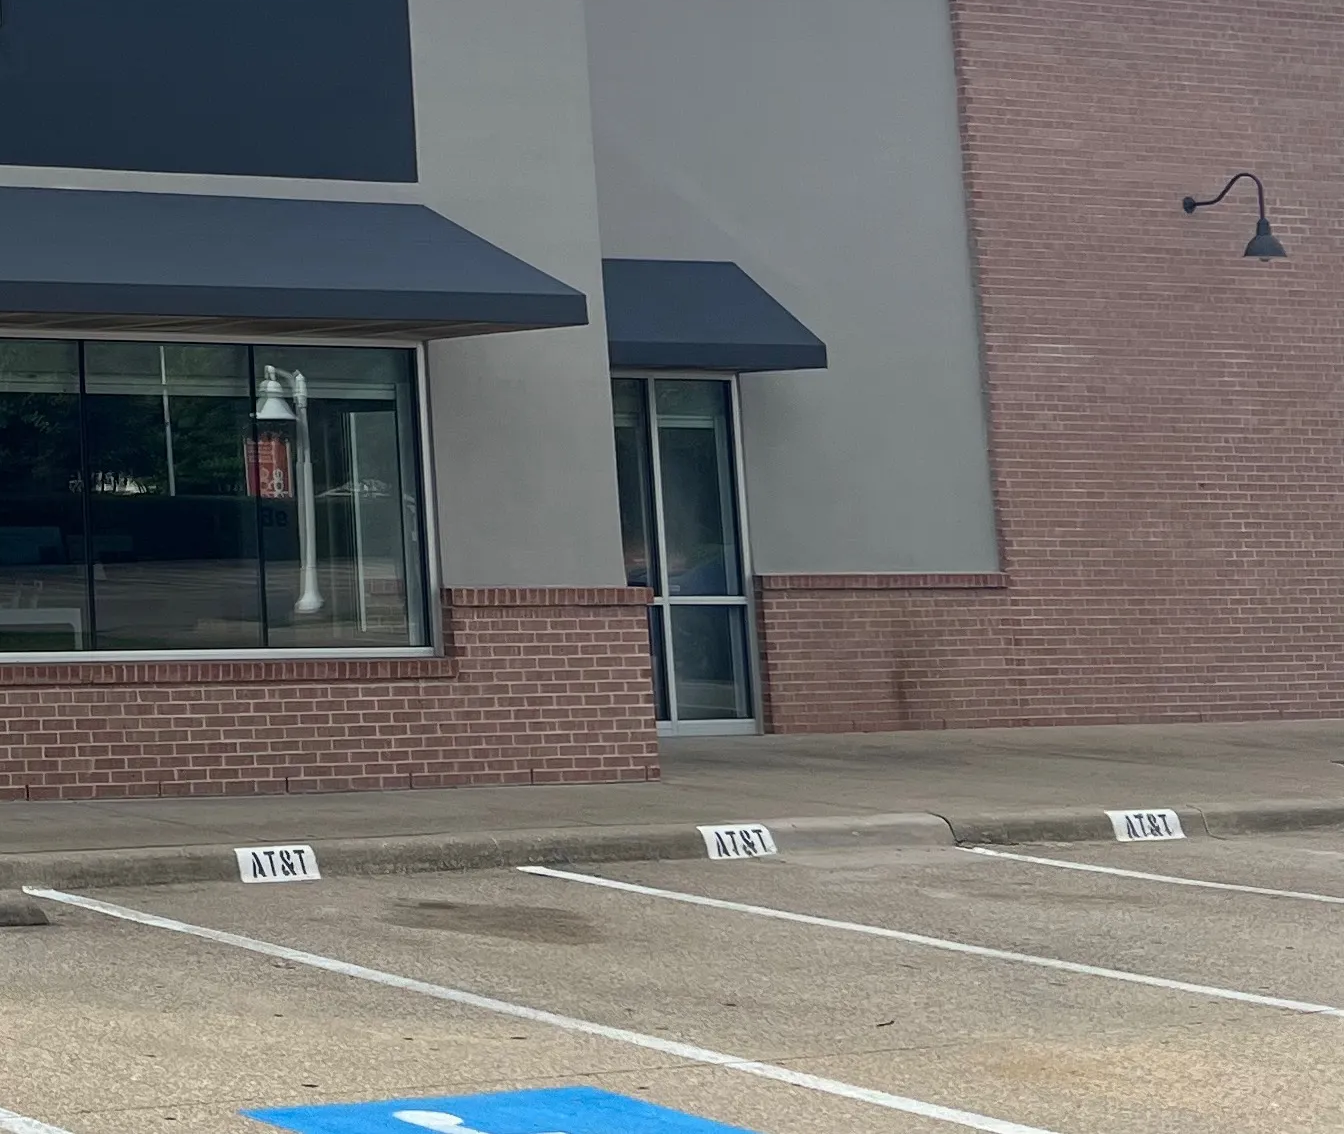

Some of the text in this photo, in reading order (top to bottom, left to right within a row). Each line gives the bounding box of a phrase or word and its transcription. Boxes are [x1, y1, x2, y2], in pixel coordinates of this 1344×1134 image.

[1124, 813, 1173, 839] AT&T
[714, 829, 768, 858] AT&T
[251, 849, 308, 879] AT&T
